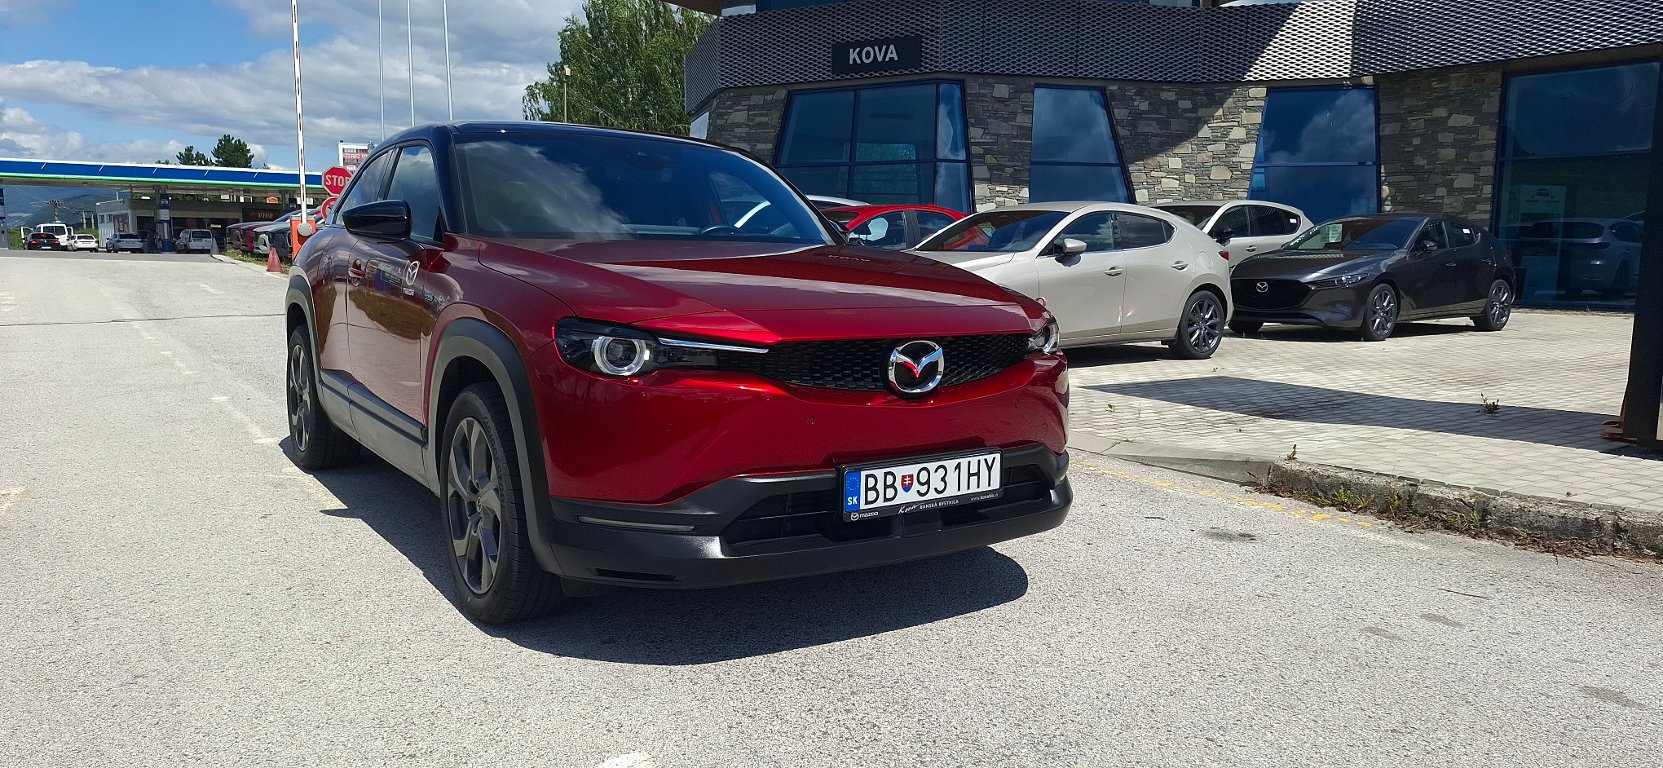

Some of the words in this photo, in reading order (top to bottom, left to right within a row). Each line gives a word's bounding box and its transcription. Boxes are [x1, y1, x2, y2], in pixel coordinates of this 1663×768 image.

[849, 44, 898, 64] KOVA
[864, 470, 898, 505] BB
[916, 456, 996, 497] 931HY
[847, 495, 858, 505] SK
